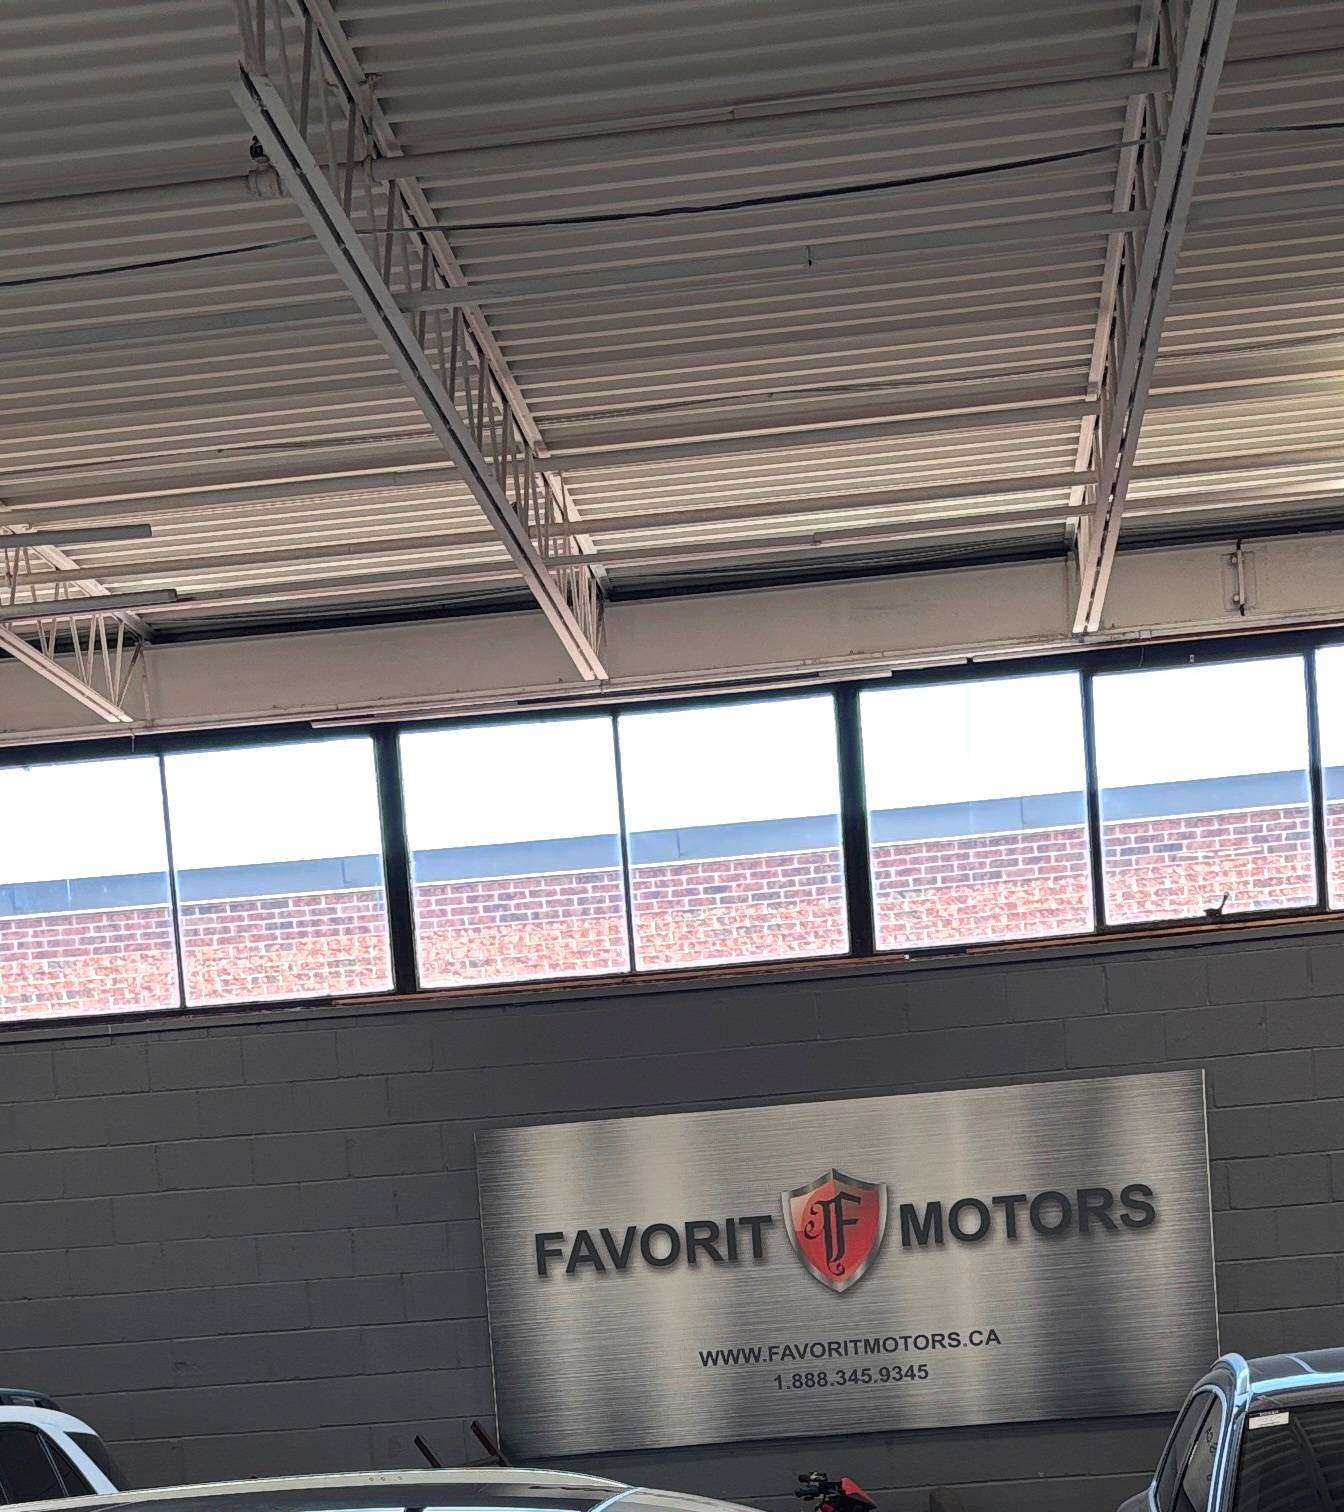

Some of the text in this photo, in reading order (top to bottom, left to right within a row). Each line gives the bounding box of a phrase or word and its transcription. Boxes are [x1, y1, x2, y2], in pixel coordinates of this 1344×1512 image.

[534, 1214, 773, 1277] FAVORIT
[899, 1183, 1156, 1249] MOTORS
[699, 1328, 1002, 1369] WWW.FAVORITMOTORS.CA
[773, 1363, 930, 1392] 1.888.345.9345
